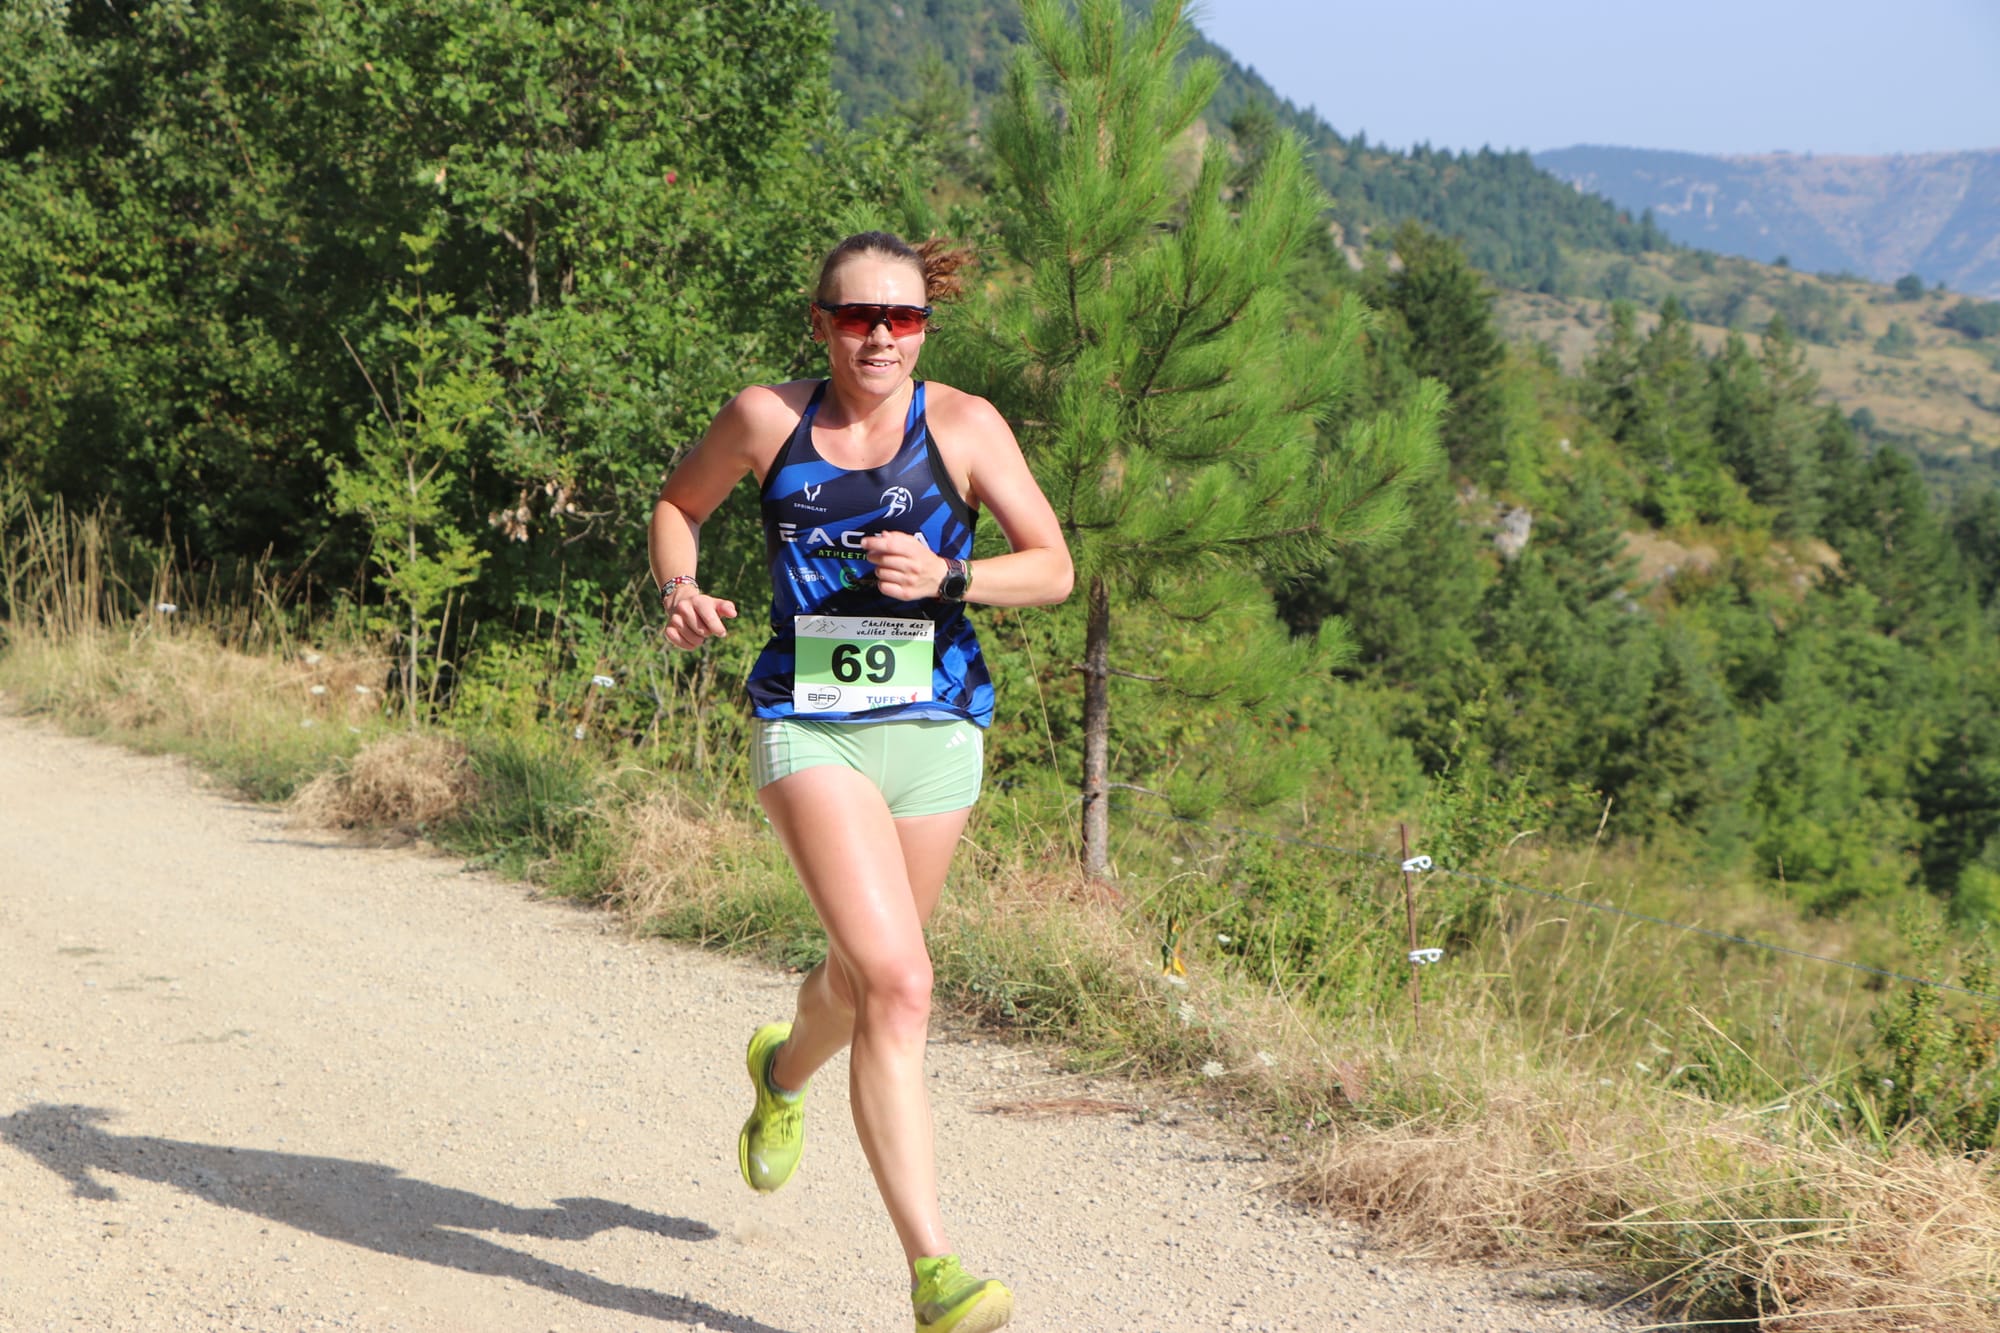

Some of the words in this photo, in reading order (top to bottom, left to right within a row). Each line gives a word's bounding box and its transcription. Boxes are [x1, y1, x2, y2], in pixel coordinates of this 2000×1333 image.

[793, 502, 827, 512] SPRINGART
[778, 522, 931, 551] EACA
[818, 549, 868, 561] ATHLETI
[861, 620, 905, 630] Challenge
[856, 628, 886, 636] vallées
[831, 643, 896, 684] 69
[807, 693, 837, 702] BFP
[866, 696, 906, 704] TUFF'S
